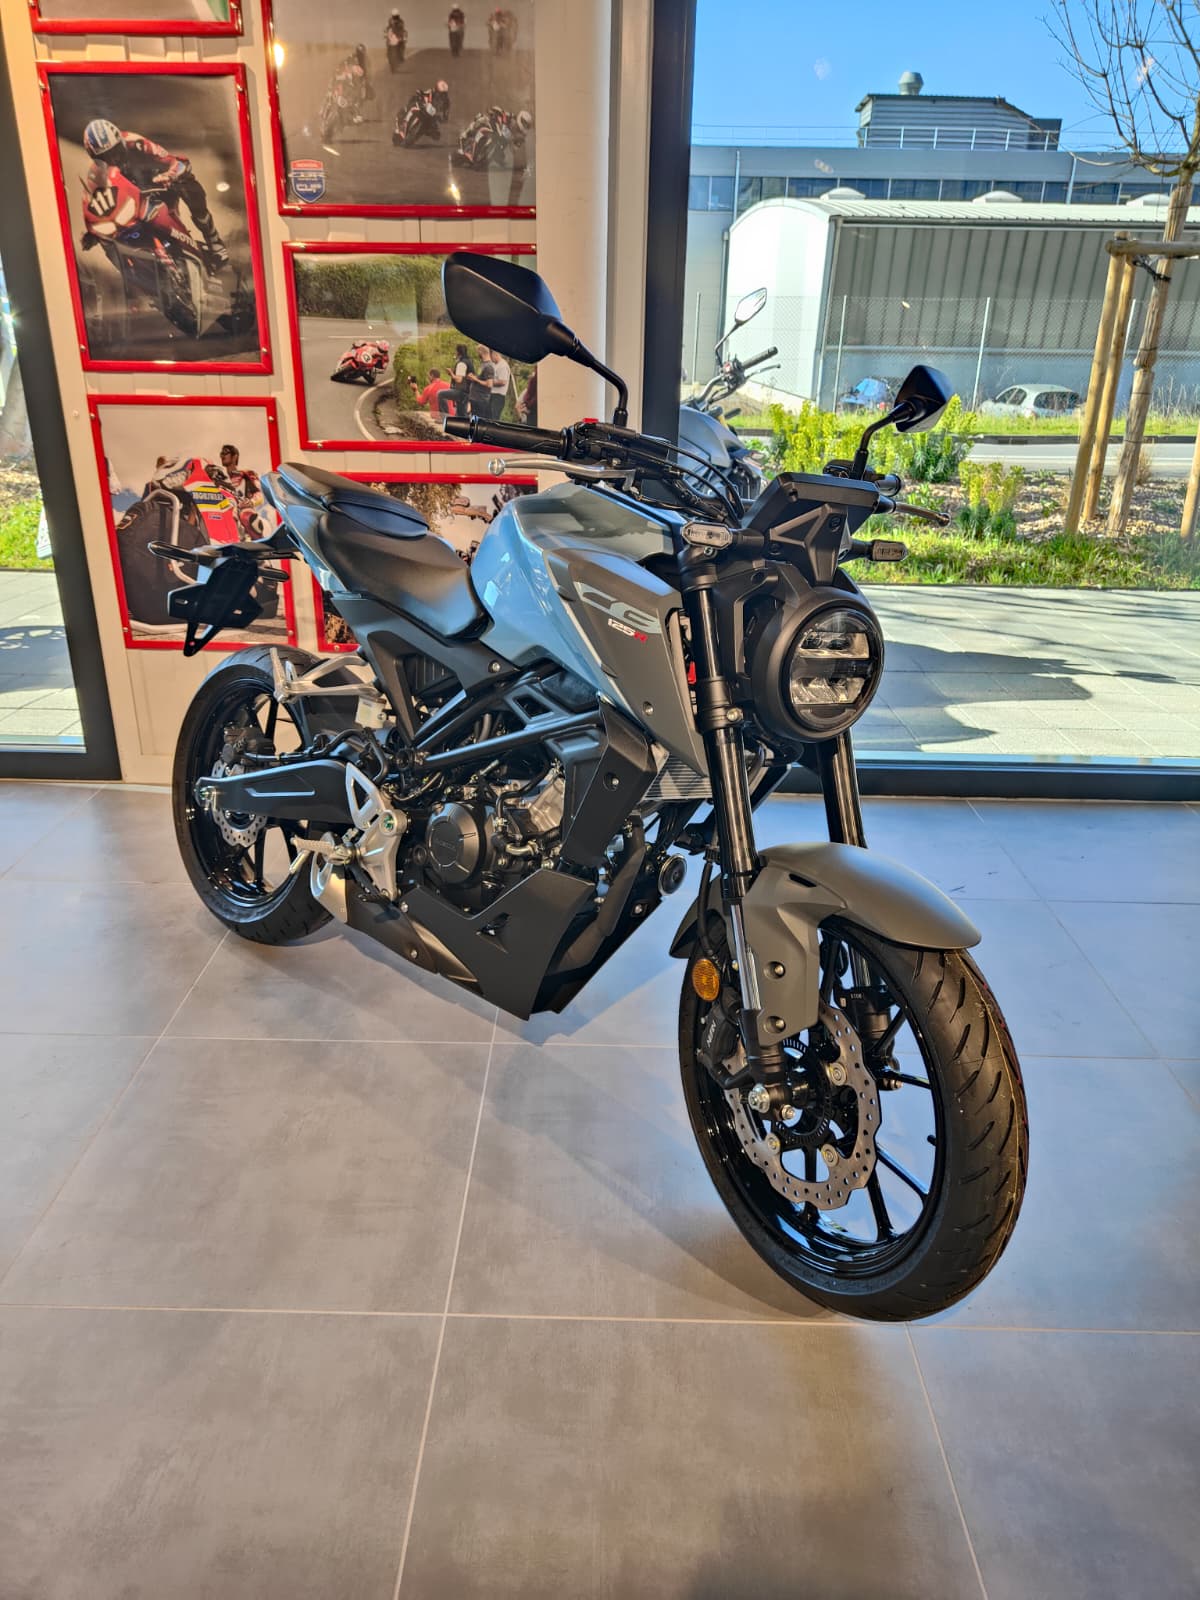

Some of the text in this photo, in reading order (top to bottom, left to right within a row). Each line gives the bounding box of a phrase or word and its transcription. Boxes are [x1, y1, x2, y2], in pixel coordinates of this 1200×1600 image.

[90, 187, 116, 216] 111
[170, 227, 199, 251] MOTUL
[608, 618, 648, 643] 125R
